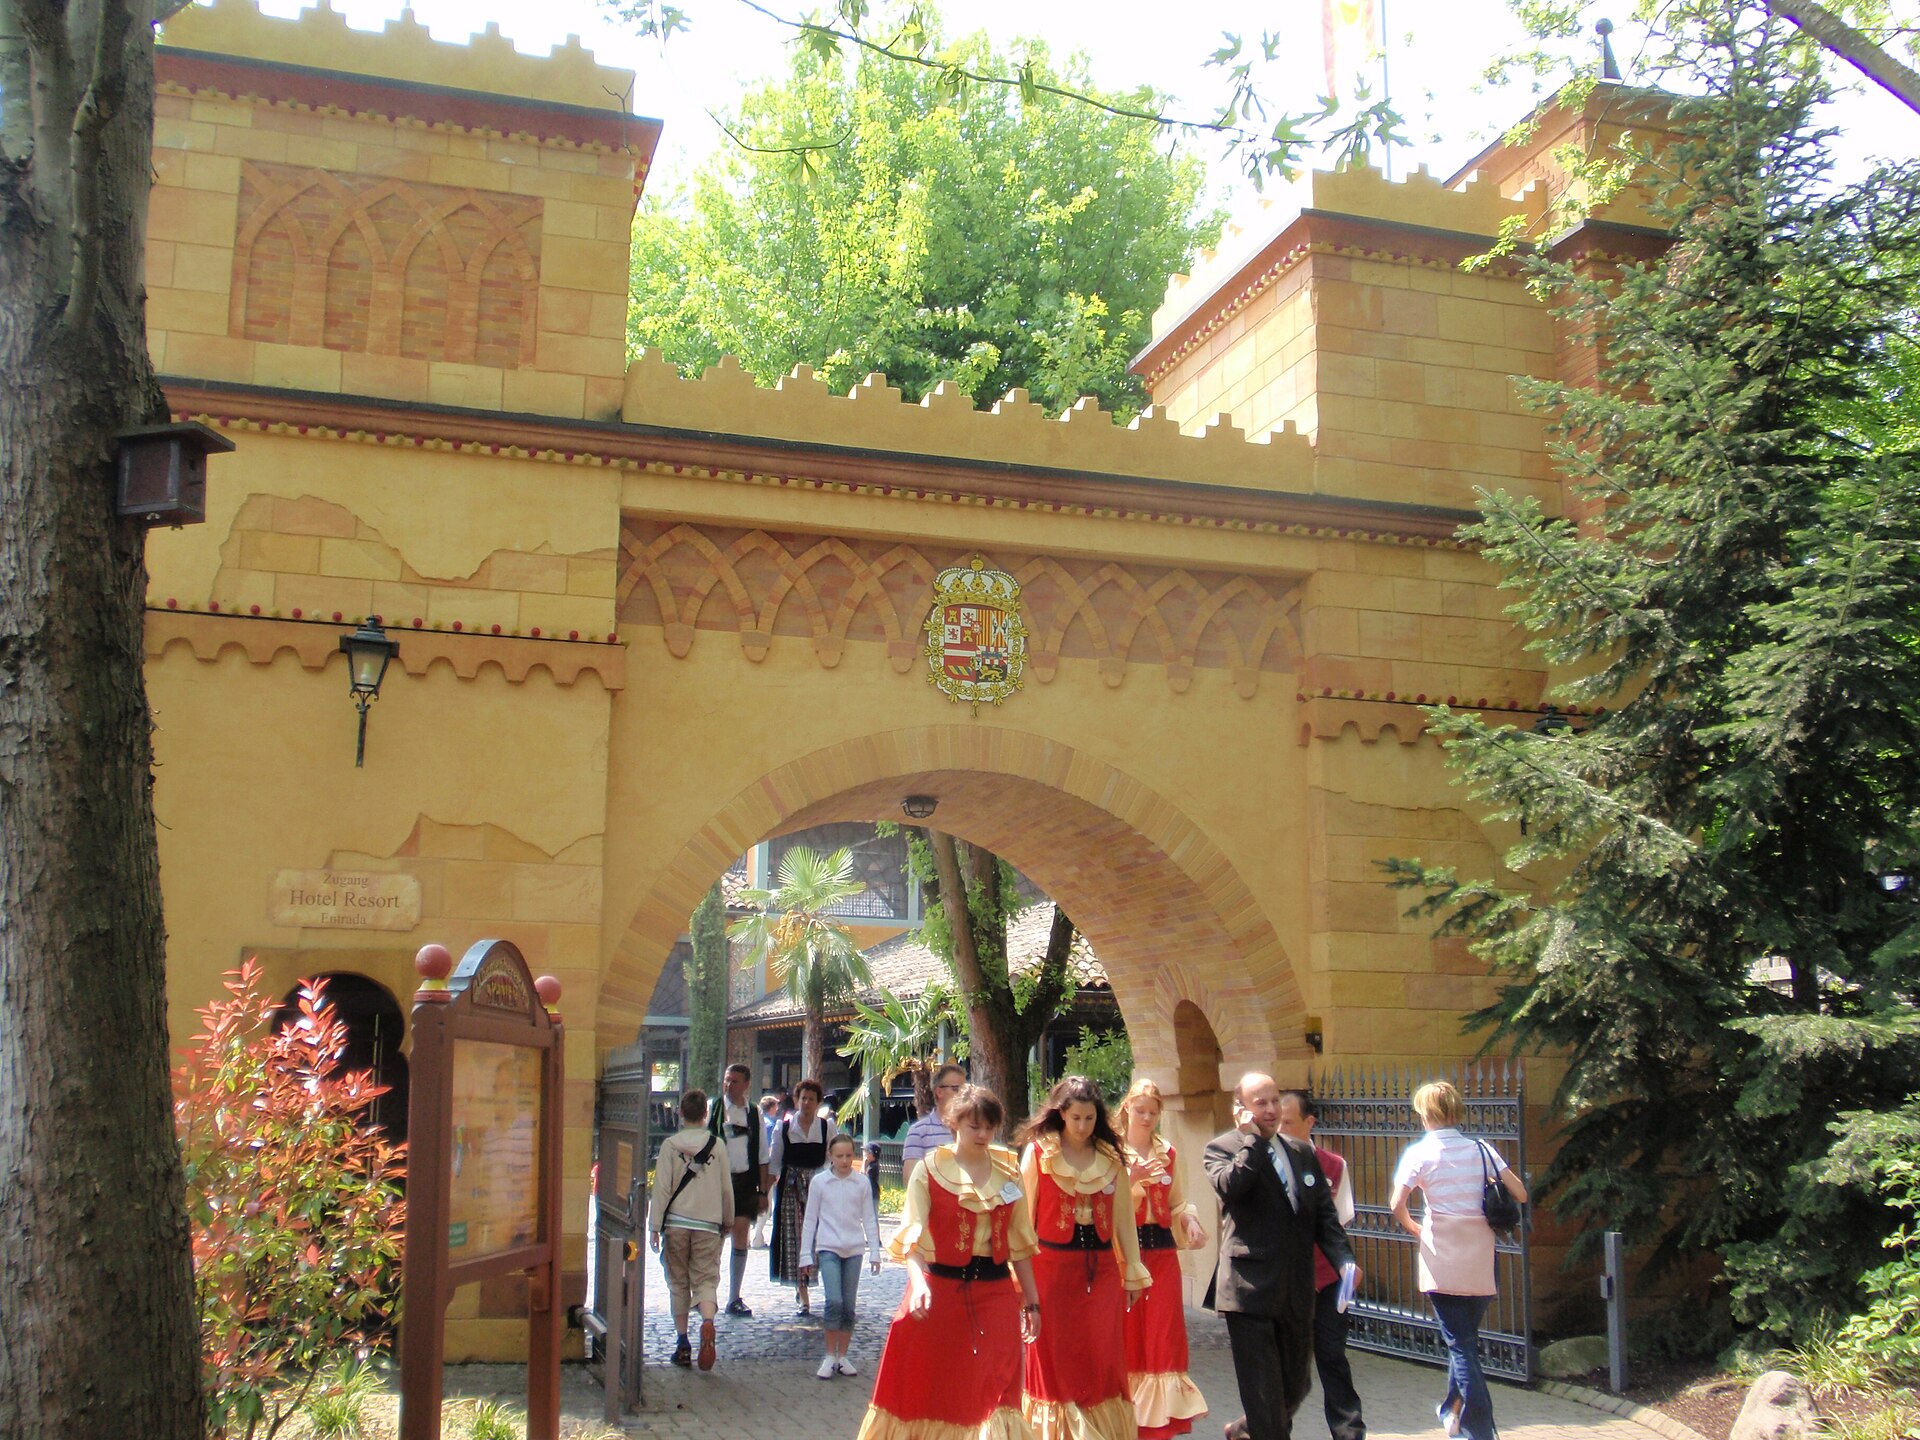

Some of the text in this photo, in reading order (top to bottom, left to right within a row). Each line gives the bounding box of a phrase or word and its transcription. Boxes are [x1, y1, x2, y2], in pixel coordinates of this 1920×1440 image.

[323, 872, 369, 888] Zugang
[289, 889, 400, 908] Hotel Resort
[320, 912, 366, 925] Entrada
